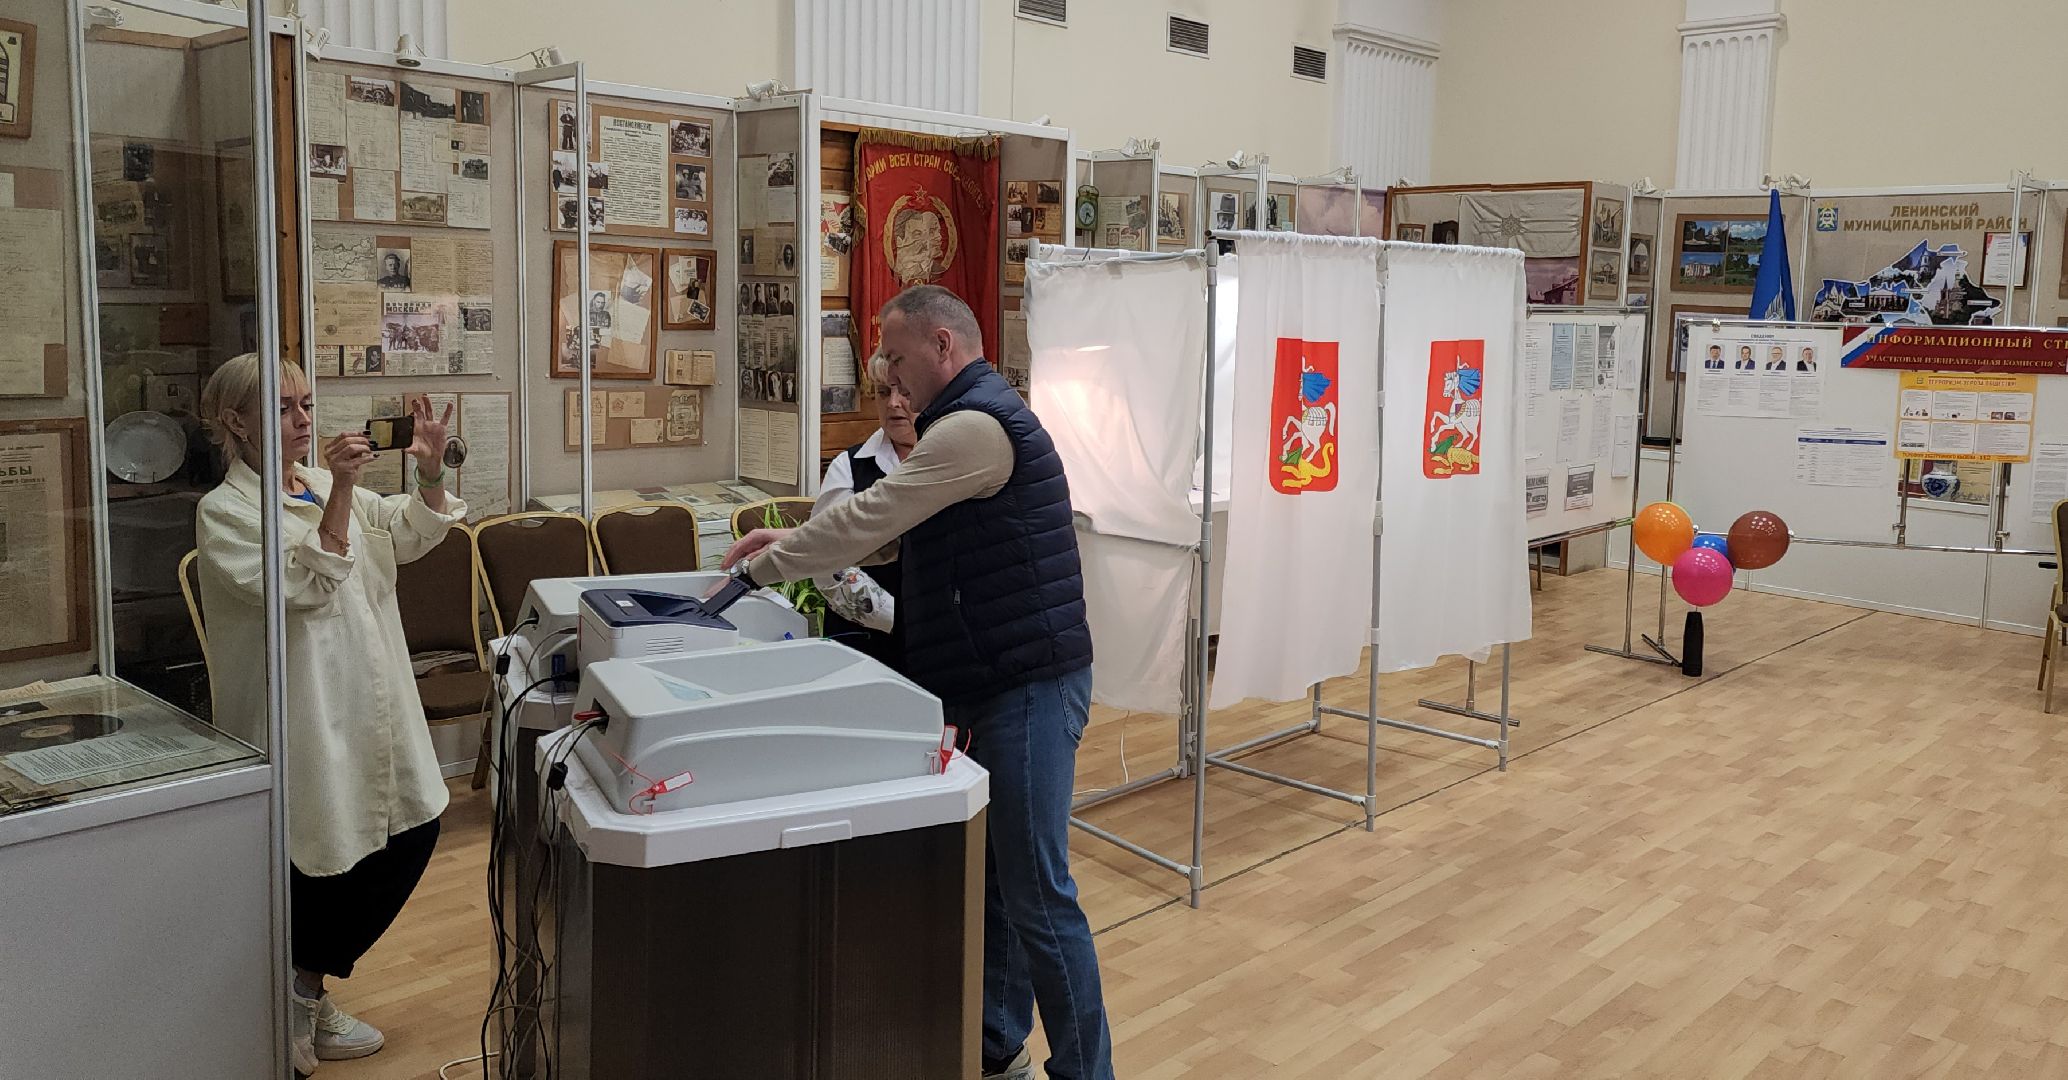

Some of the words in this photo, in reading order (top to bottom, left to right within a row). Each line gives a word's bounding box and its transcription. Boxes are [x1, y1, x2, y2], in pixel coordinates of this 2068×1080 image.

[889, 153, 911, 168] ВСЕХ
[1890, 202, 1980, 217] ЛЕНИНСКИЙ
[1843, 217, 1973, 232] МУНИЦИПАЛЬНЫЙ
[1867, 334, 2032, 348] ИНФОРМАЦИОННЫЙ
[1866, 354, 1922, 363] УЧАСТКОВАЯ
[1924, 356, 2001, 366] ИЗБИРАТЕЛЬНАЯ
[2003, 359, 2053, 367] КОМИССИЯ
